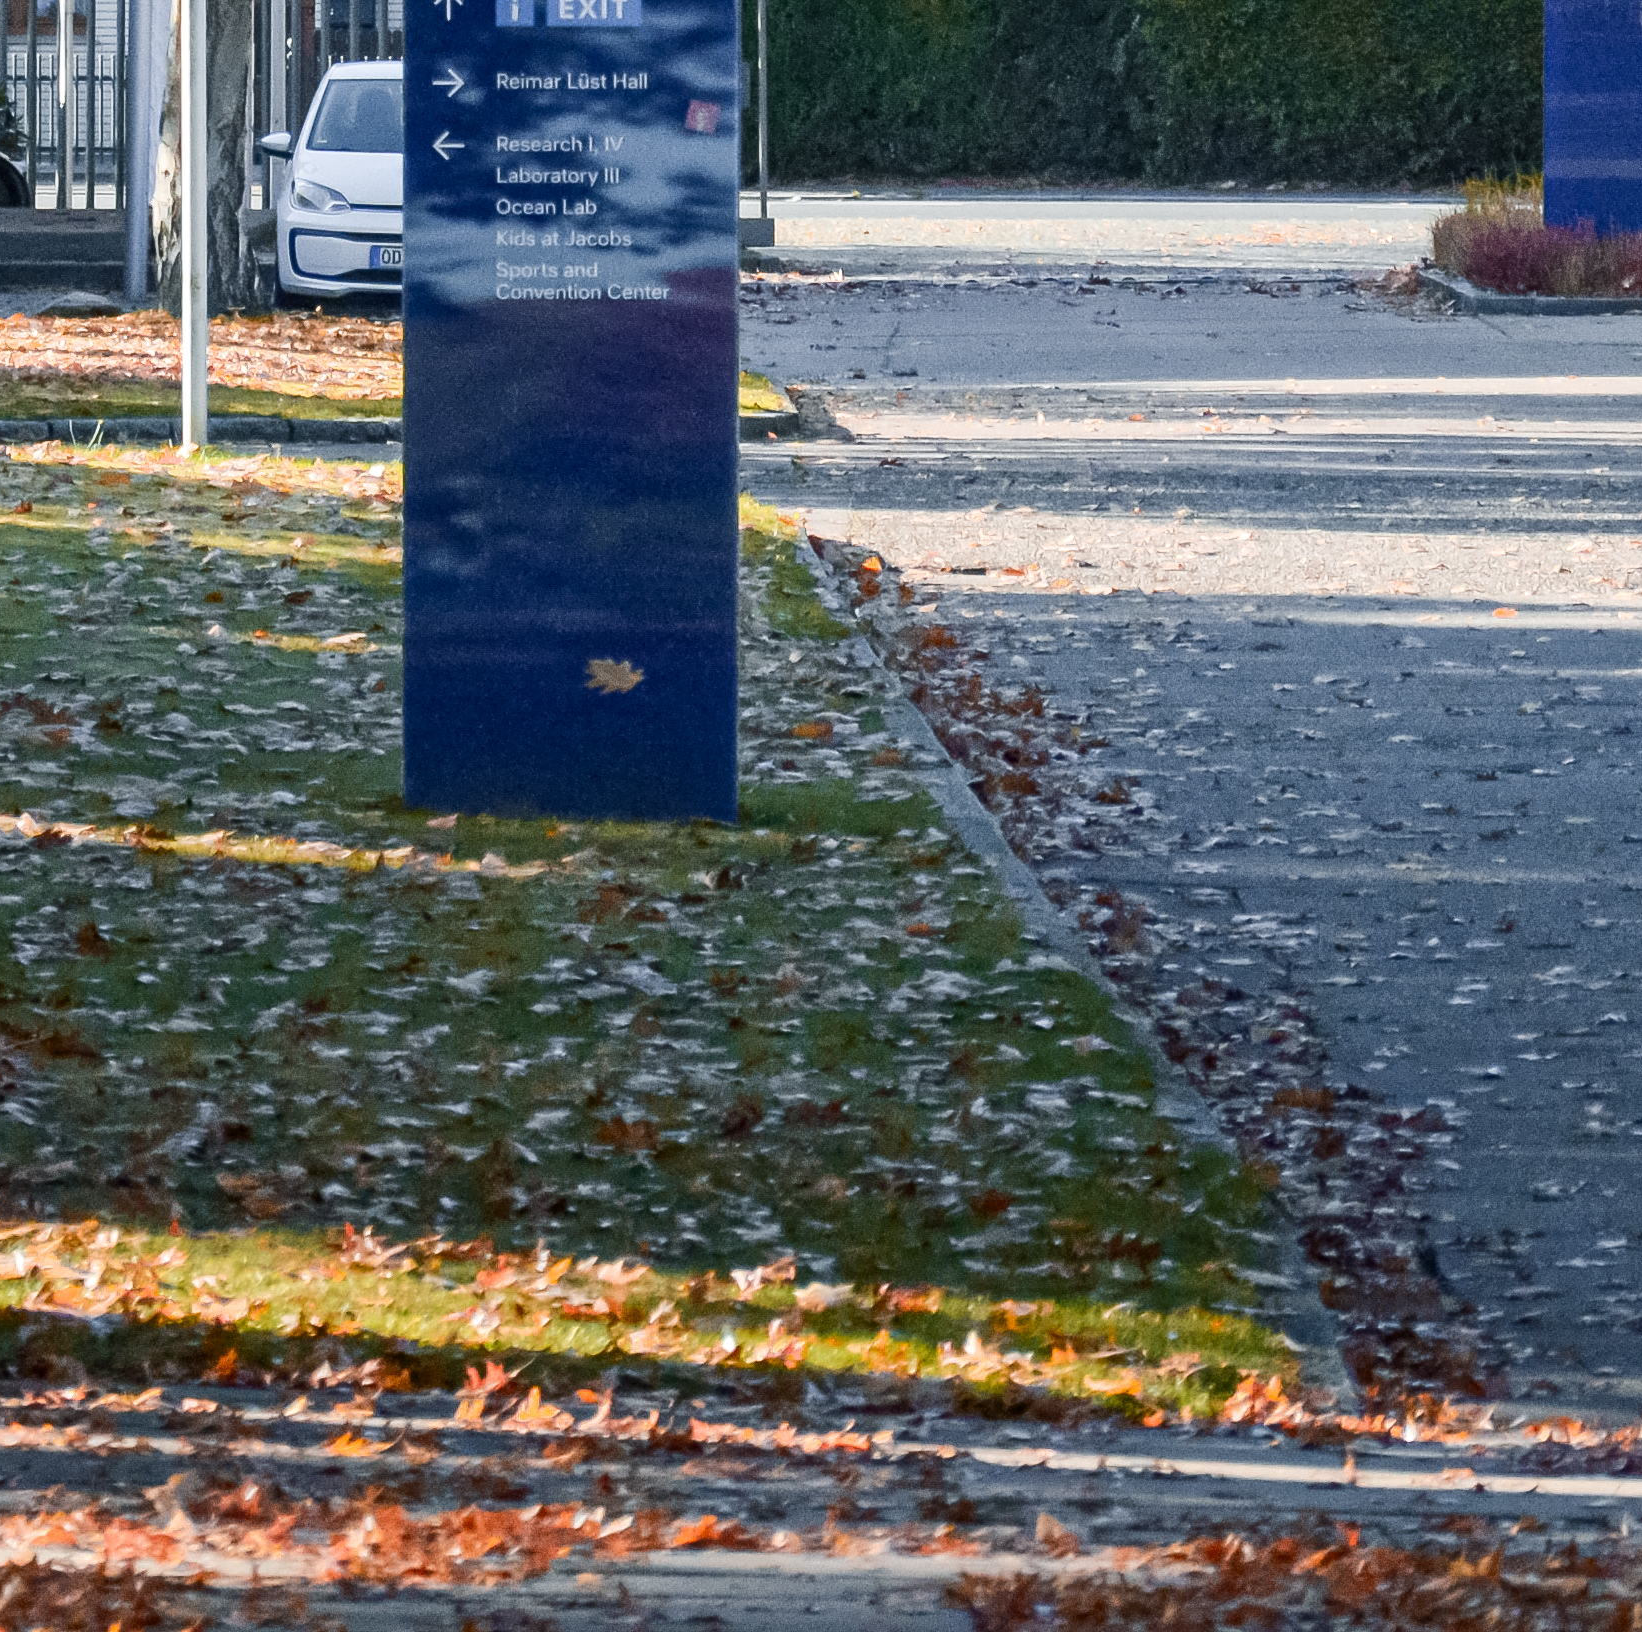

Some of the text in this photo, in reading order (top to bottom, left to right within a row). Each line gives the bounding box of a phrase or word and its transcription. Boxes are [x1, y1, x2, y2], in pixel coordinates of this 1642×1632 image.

[496, 72, 649, 90] Reimar Lüst Hall
[496, 135, 625, 156] Research I, IV
[496, 167, 620, 187] Laboratory III
[496, 198, 597, 215] Ocean Lab
[496, 230, 633, 246] Kids at Jacobs
[382, 249, 401, 263] OD
[496, 261, 599, 281] Sports and
[496, 283, 671, 300] Convention Center
